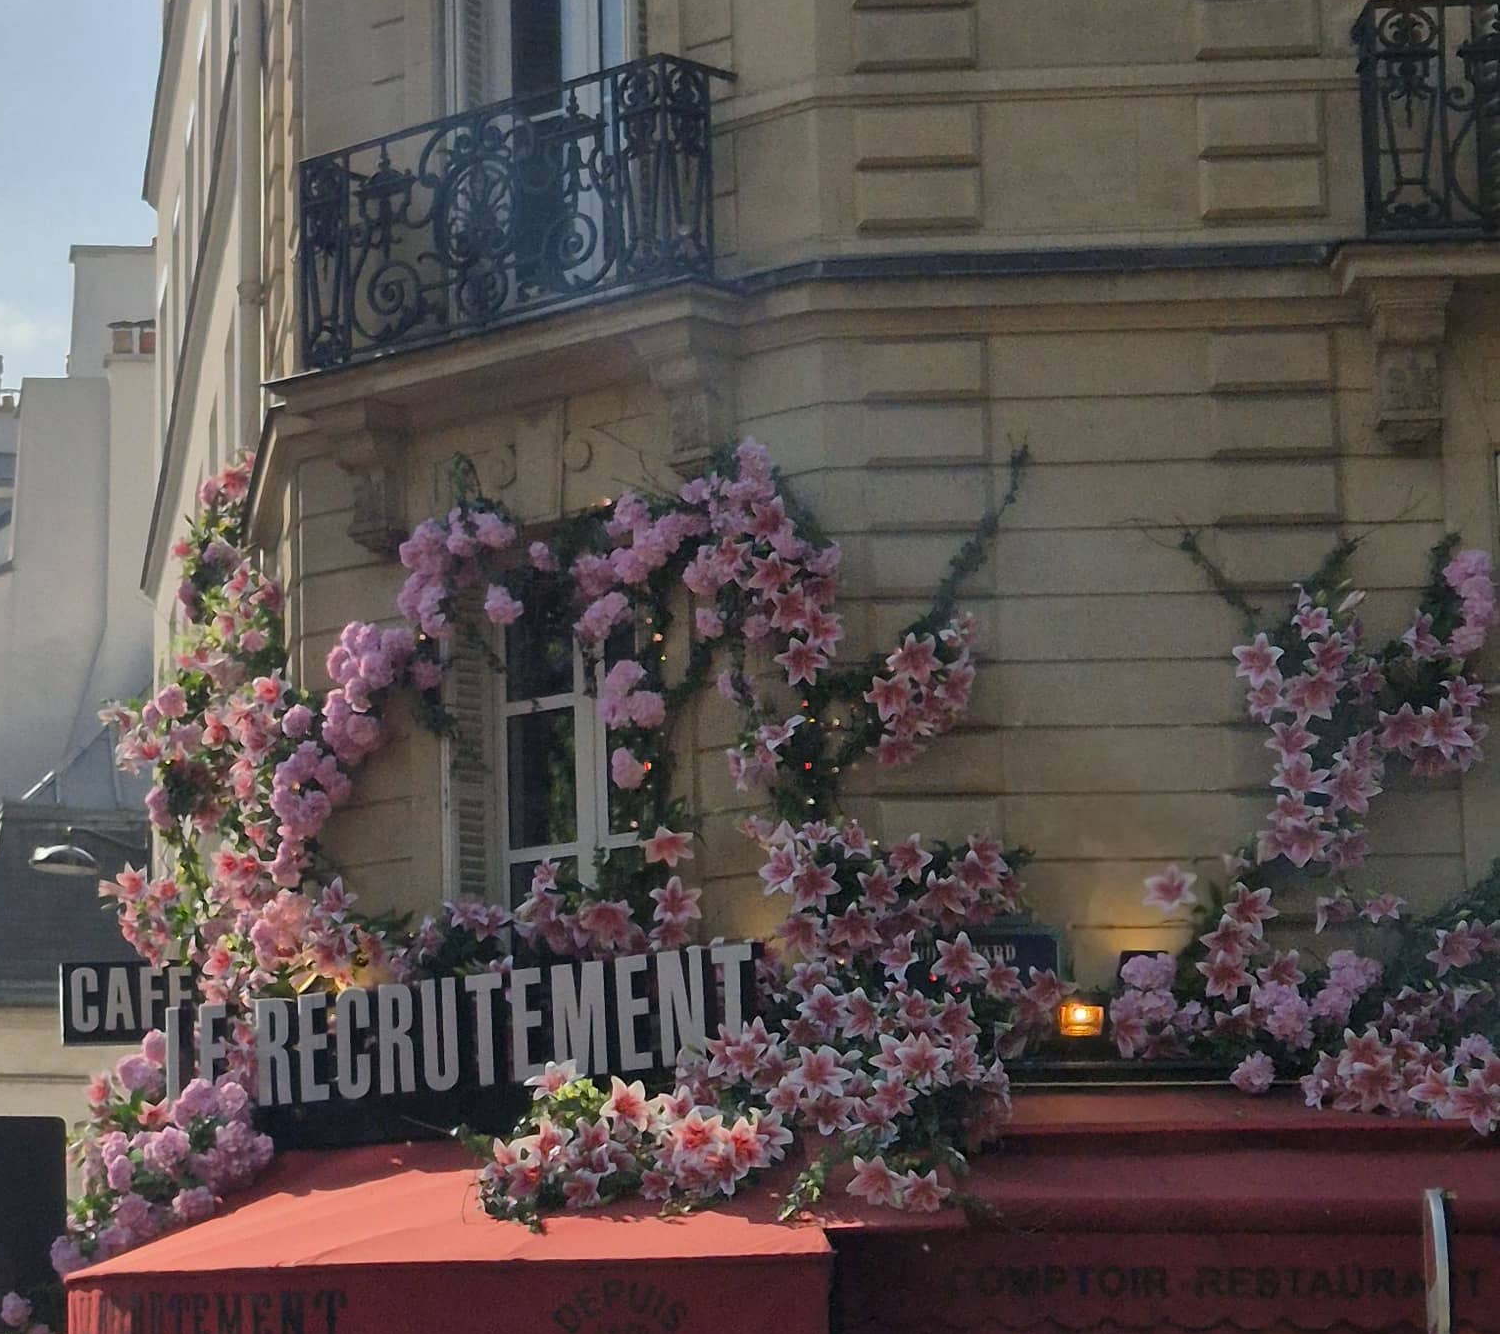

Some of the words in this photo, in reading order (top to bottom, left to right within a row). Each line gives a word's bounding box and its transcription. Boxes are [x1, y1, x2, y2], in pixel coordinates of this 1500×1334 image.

[255, 943, 753, 1107] RECRUTEMENT
[553, 1278, 689, 1334] DEPUIS
[1195, 1265, 1483, 1300] RESTAURAT
